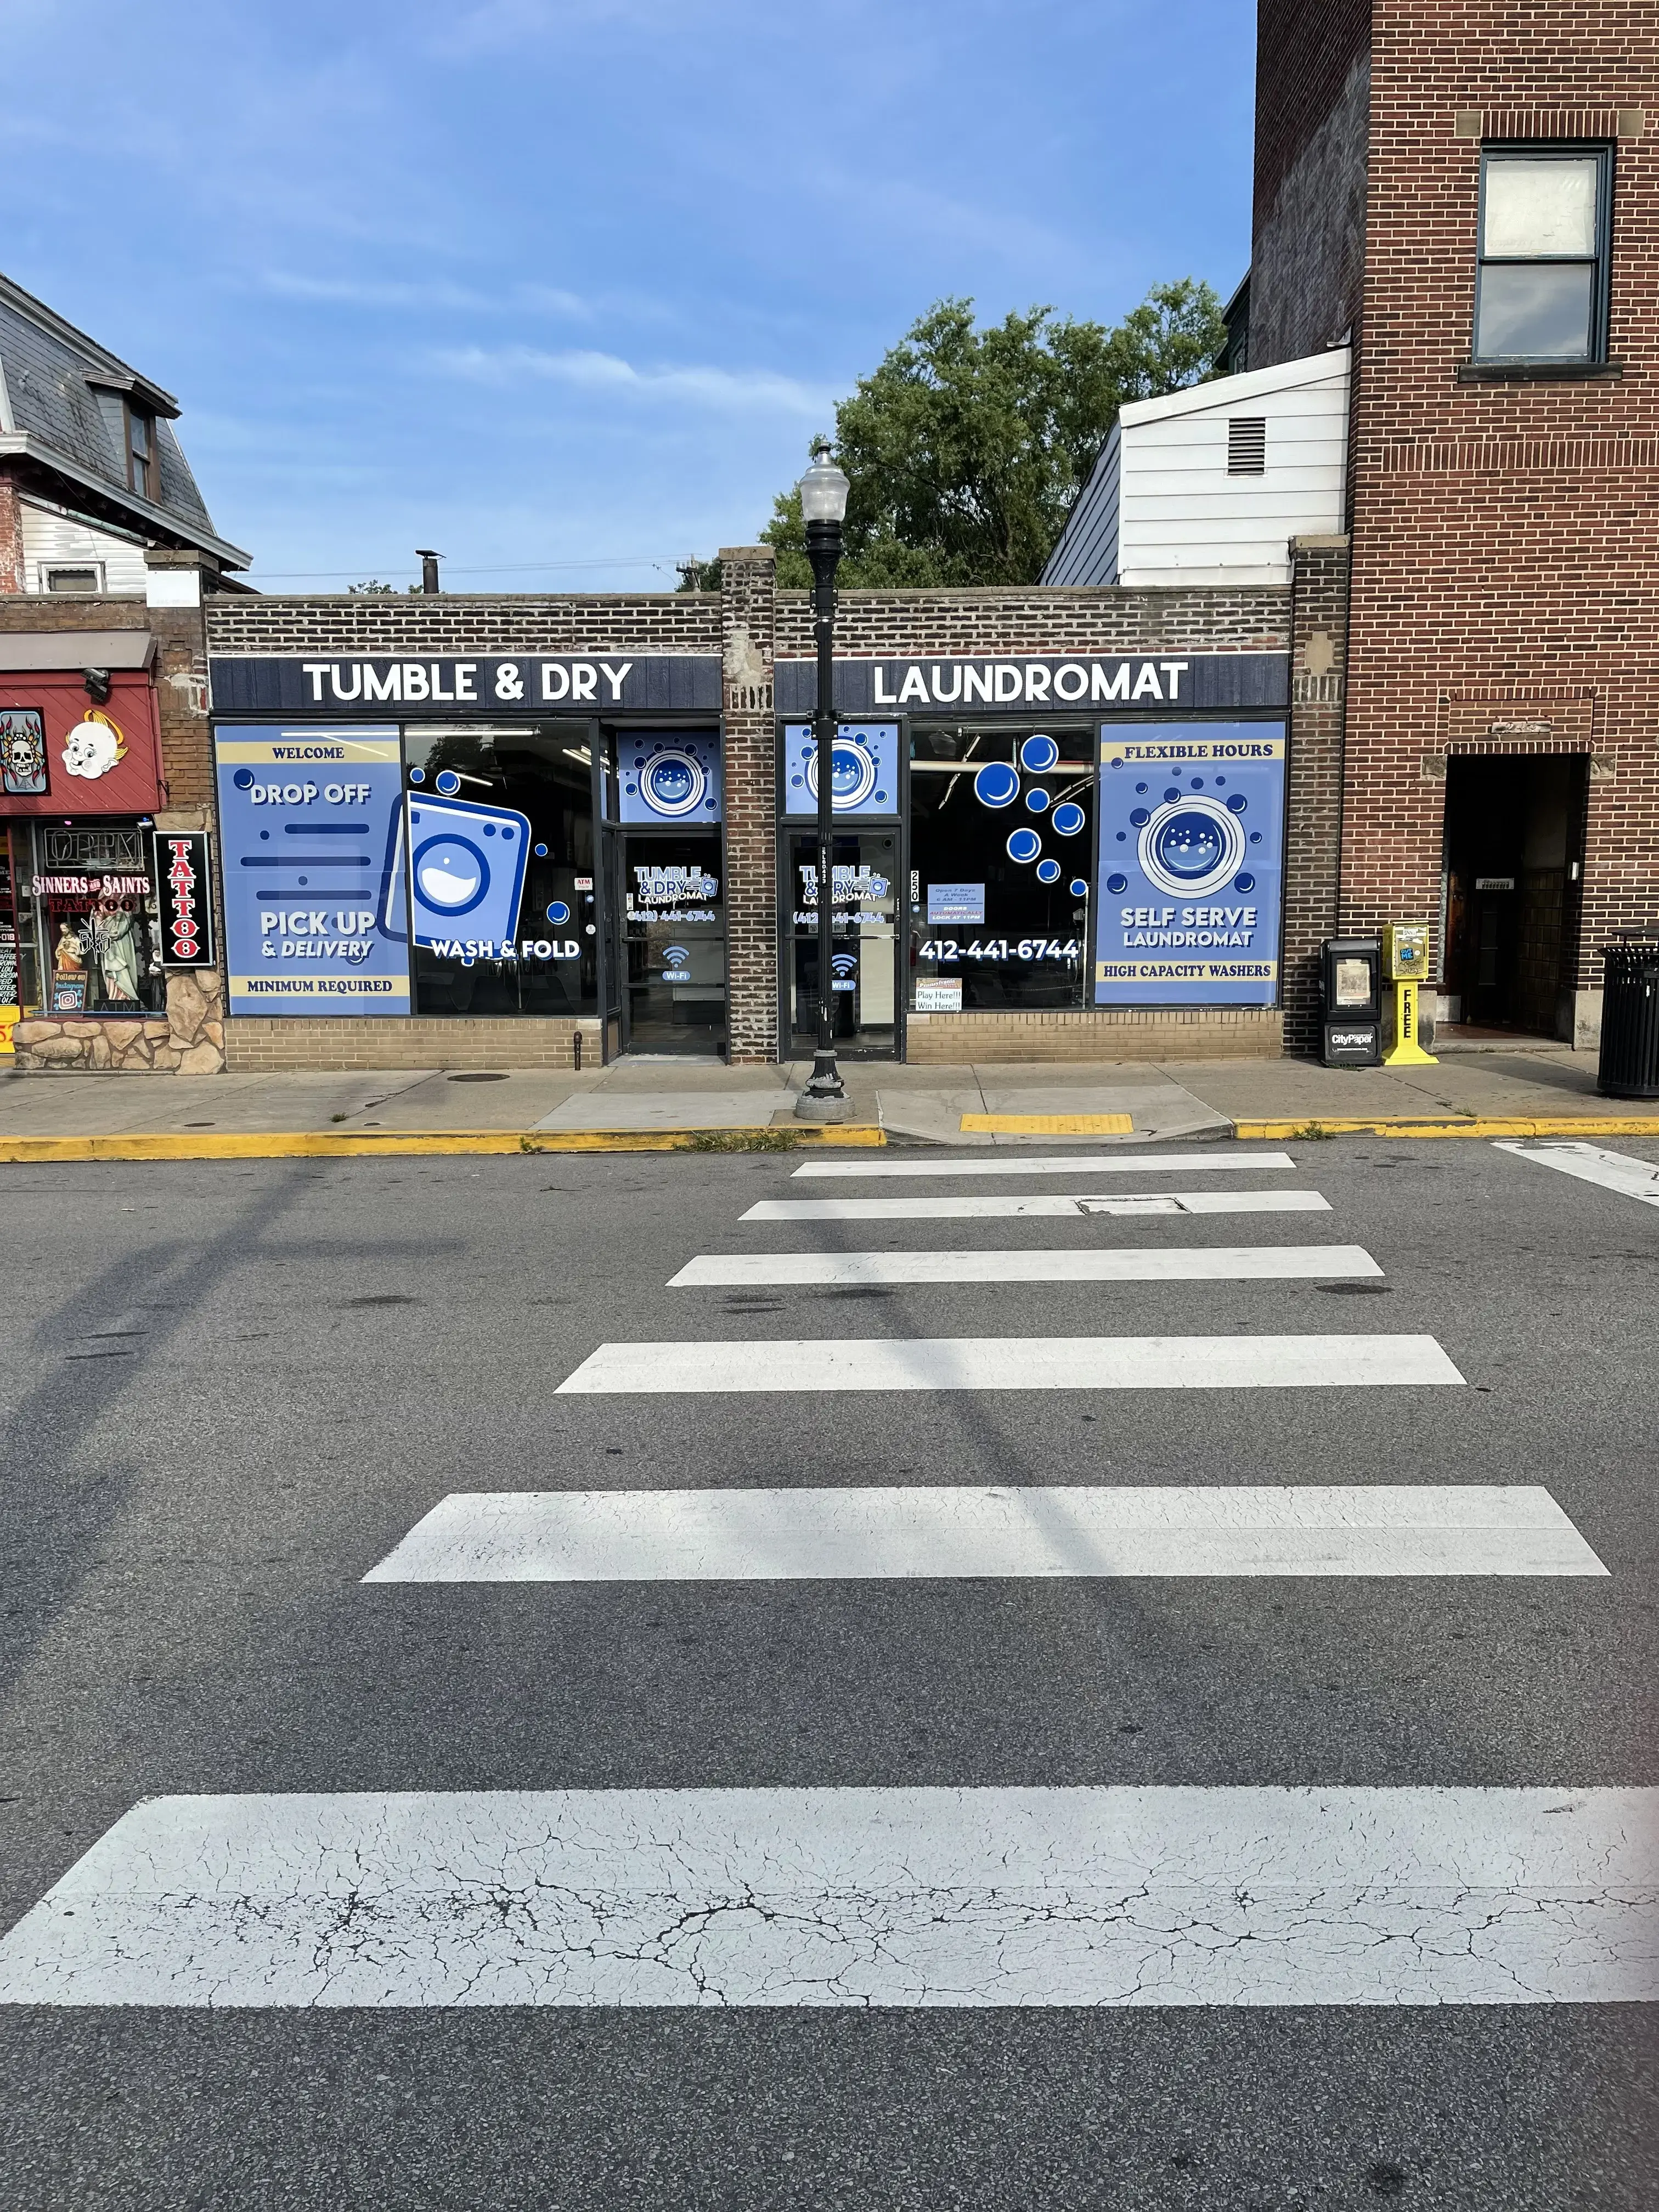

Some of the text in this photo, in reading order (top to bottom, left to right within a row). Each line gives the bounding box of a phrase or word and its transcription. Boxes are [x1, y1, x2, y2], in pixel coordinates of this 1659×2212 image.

[303, 663, 633, 701] TUMBLE & DRY
[874, 662, 1188, 703] LAUNDROMAT
[272, 747, 345, 759] WELCOME
[1125, 744, 1273, 759] FLEXIBLE HOURS
[251, 784, 371, 805] DROP OFF
[634, 866, 702, 882] TUMBLE
[32, 874, 88, 896] SINNERS
[103, 874, 150, 896] SAINTS
[640, 881, 686, 895] & DRY
[49, 899, 134, 912] TATTOO
[167, 840, 201, 958] TATTOO
[638, 892, 708, 904] LAUNDROMAT
[261, 911, 377, 936] PICK UP
[660, 910, 715, 922] 441-6744
[1120, 907, 1257, 928] SELF SERVE
[1124, 931, 1254, 948] LAUNDROMAT
[261, 940, 375, 959] & DELIVERY
[430, 939, 582, 960] WASH & FOLD
[919, 939, 1080, 961] 412-441-6744
[1104, 965, 1271, 977] HIGH CAPACITY WASHERS
[247, 981, 392, 994] MINIMUM REQUIRED
[919, 978, 955, 988] Pennsylvania
[918, 991, 933, 1000] Play
[100, 1002, 136, 1012] ATM
[1332, 1034, 1373, 1045] CityPaper
